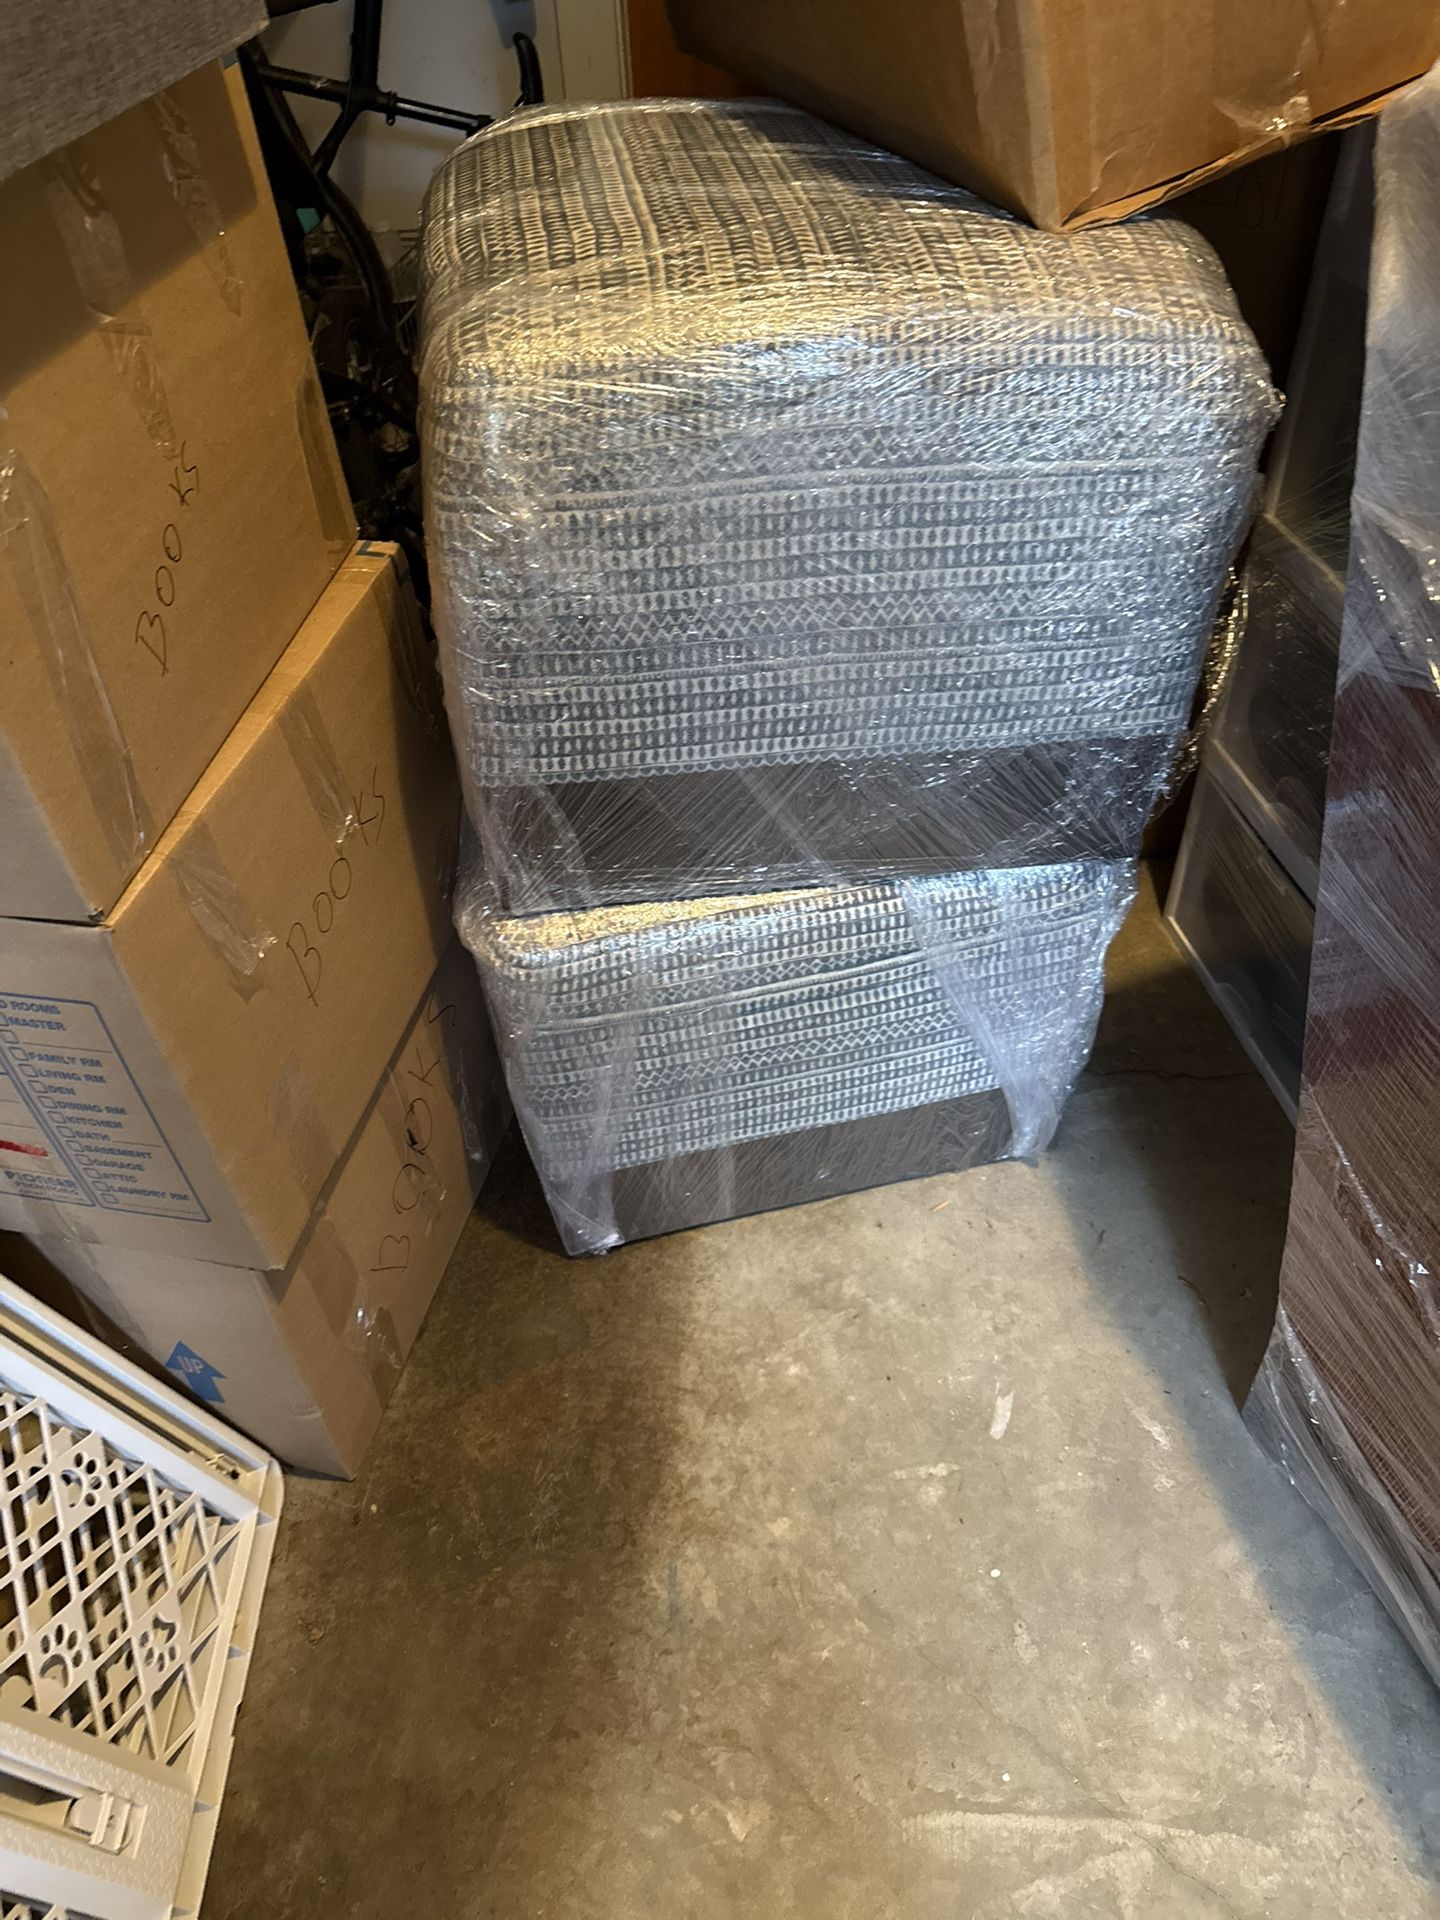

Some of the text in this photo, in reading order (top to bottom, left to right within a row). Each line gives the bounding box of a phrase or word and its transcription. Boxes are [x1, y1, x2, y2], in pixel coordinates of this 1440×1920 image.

[135, 440, 199, 677] BOOKS
[286, 765, 385, 1007] BOOKS
[8, 1016, 66, 1031] MASTER
[28, 1051, 77, 1066] FAMILY
[38, 1068, 82, 1082] LIVING
[47, 1085, 76, 1096] DEN
[55, 1100, 103, 1114] DINING
[64, 1115, 124, 1129] KITCHEN
[74, 1130, 111, 1142] BATH
[369, 987, 455, 1272] BOOKS
[84, 1144, 153, 1160] BASEMENT
[92, 1158, 145, 1172] GARAGE
[101, 1172, 138, 1183] ATTIC
[176, 1355, 205, 1374] UP
